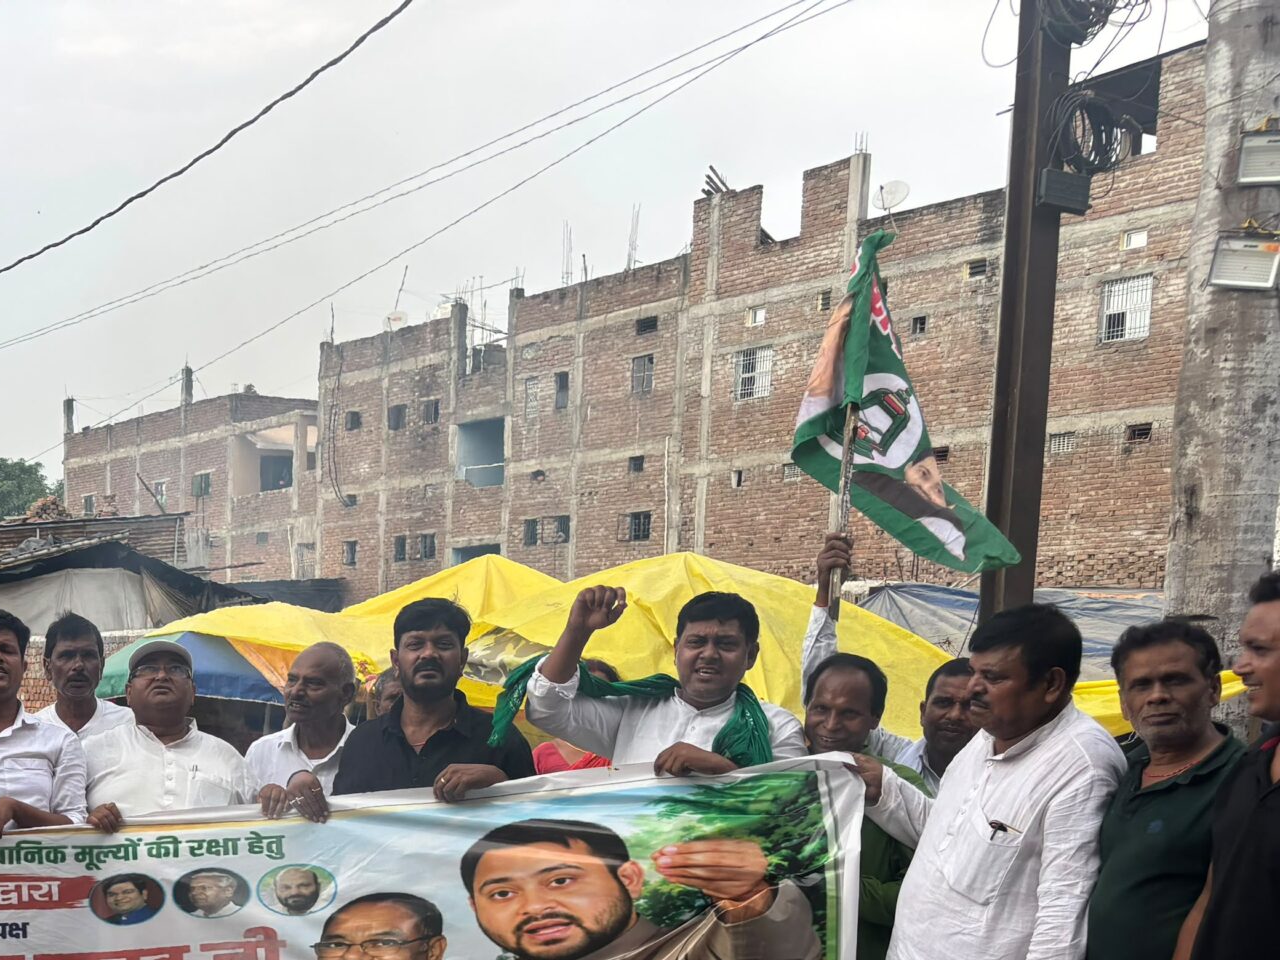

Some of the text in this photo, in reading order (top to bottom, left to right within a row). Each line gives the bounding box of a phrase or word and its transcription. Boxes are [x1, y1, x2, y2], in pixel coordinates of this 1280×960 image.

[73, 836, 142, 871] मूल्यों
[147, 834, 183, 859] की
[189, 835, 240, 857] रक्षा
[247, 831, 285, 861] हेतु
